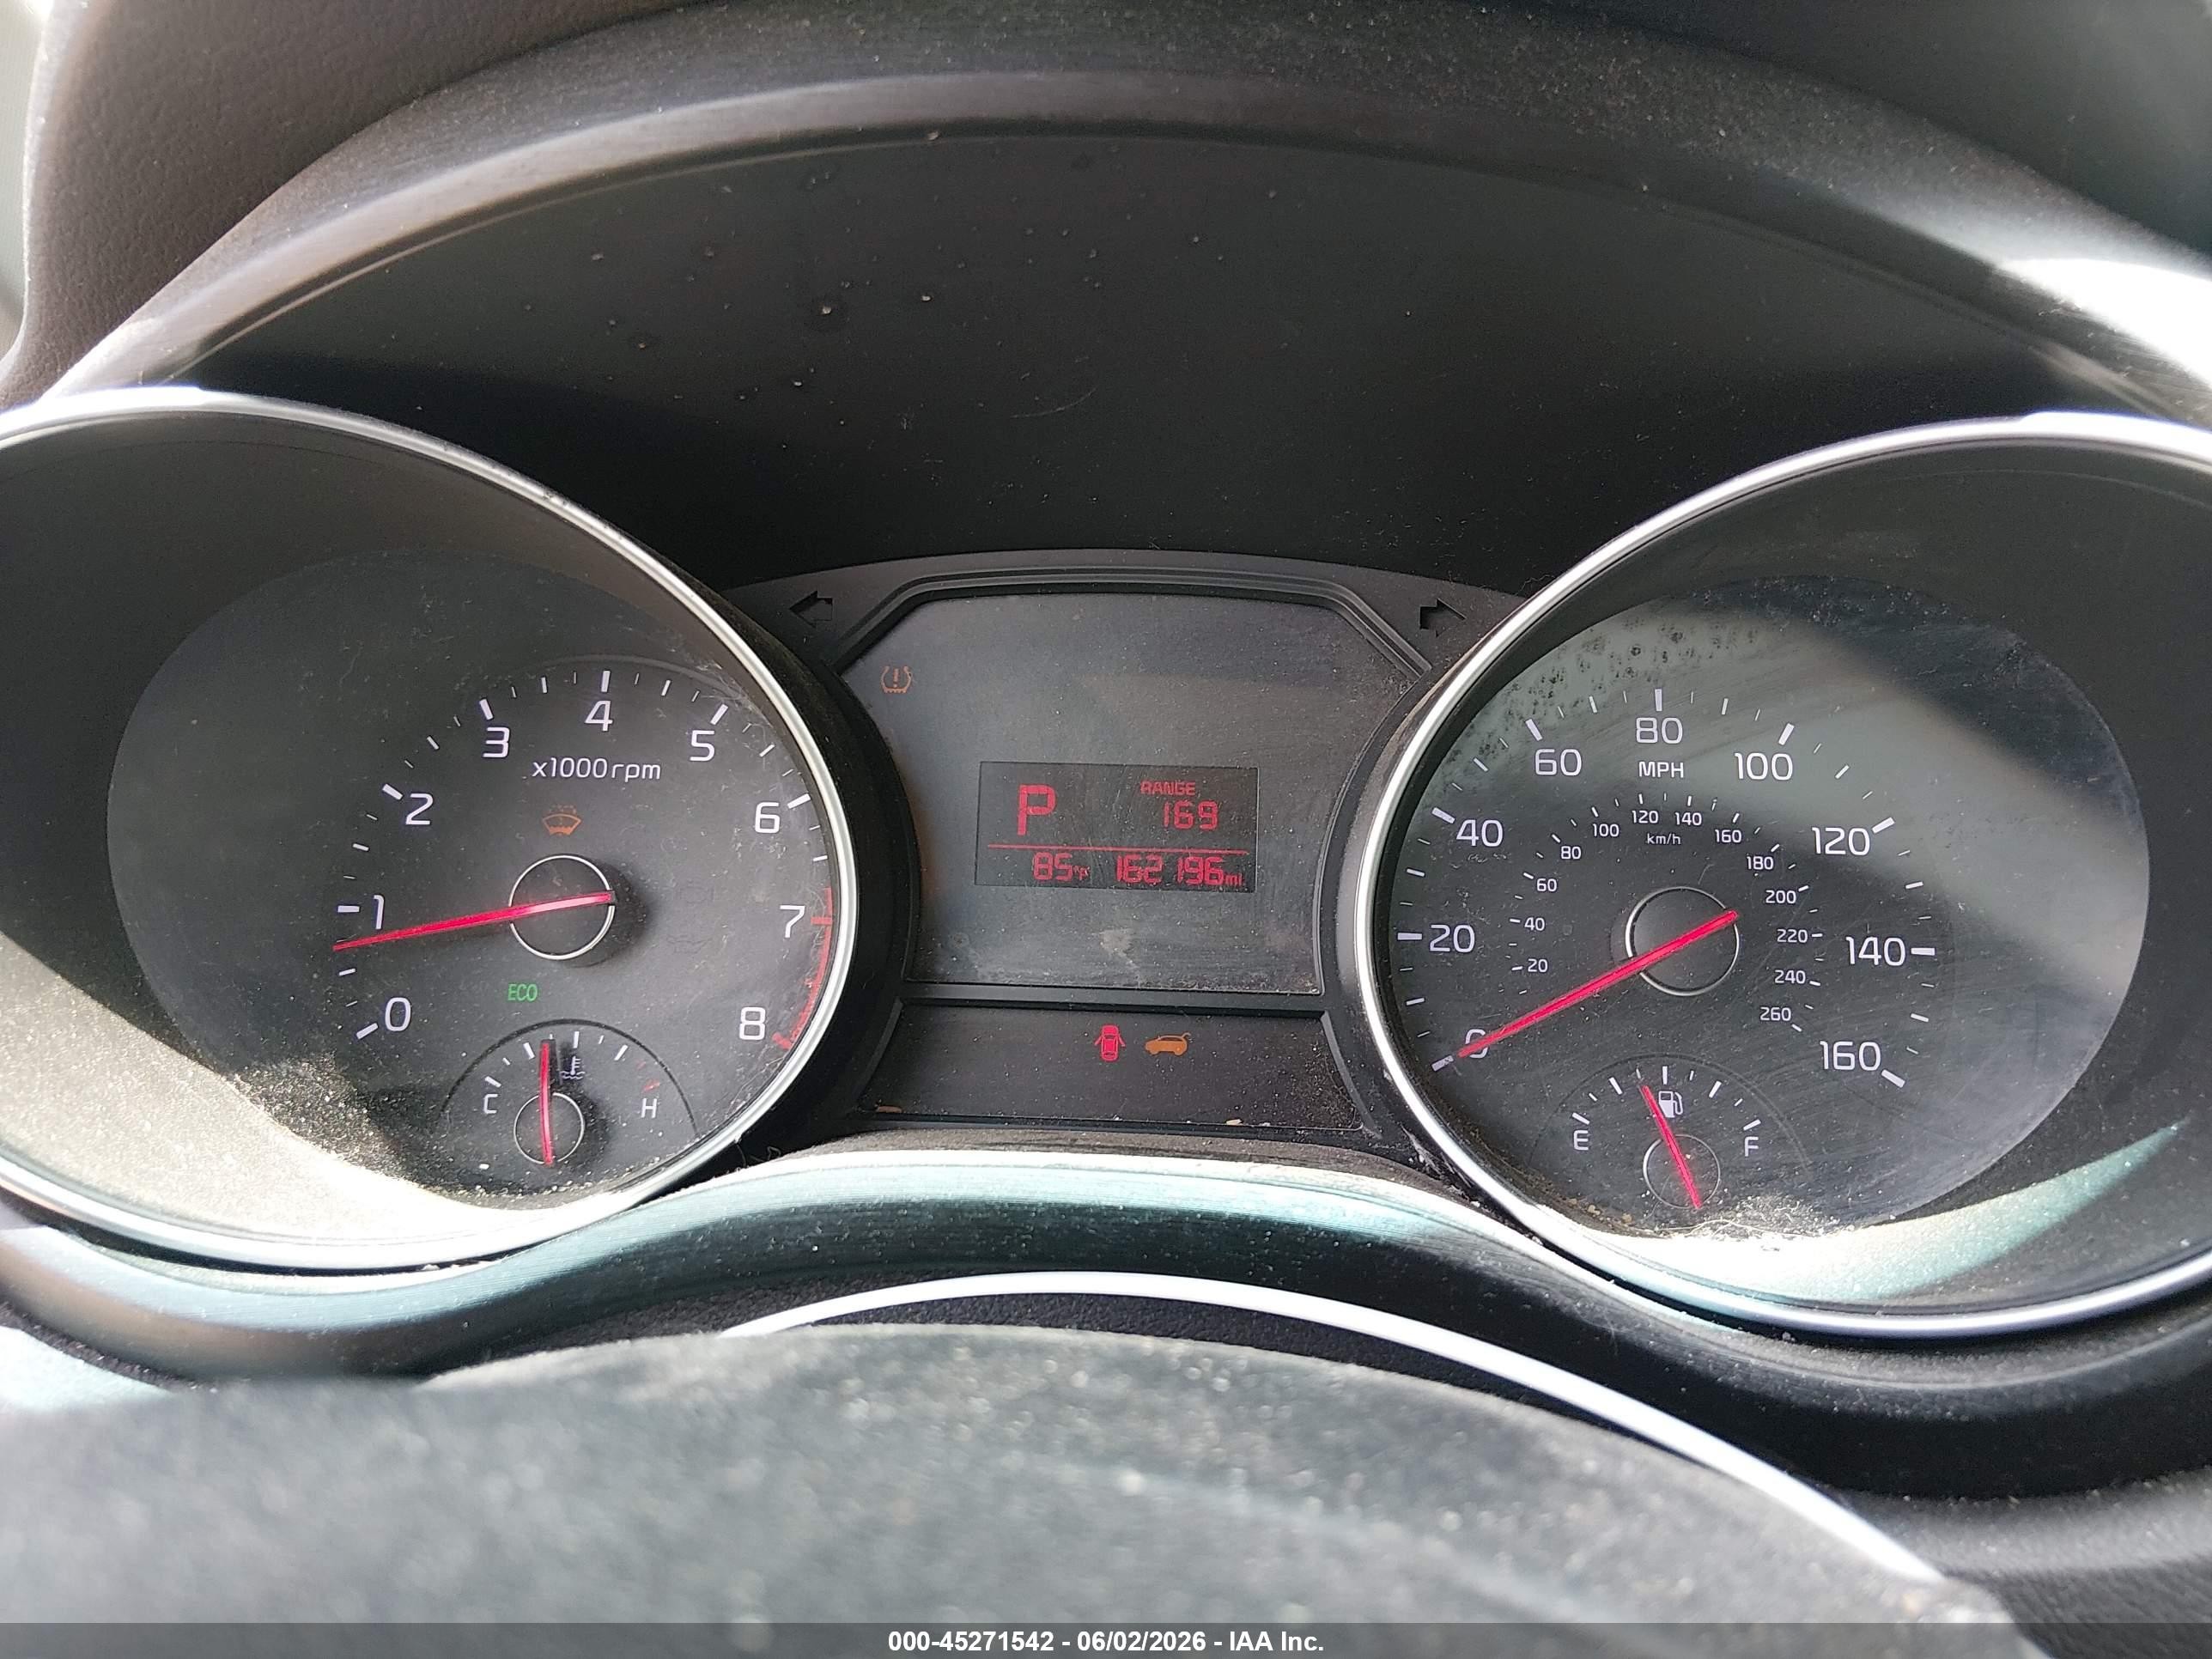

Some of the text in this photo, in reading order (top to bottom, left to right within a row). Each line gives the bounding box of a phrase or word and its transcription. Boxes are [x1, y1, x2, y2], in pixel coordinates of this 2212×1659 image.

[586, 701, 612, 731] 4
[1637, 718, 1682, 744] 80
[483, 727, 509, 757] 3
[690, 731, 714, 761] 5
[1535, 750, 1581, 775] 60
[1639, 762, 1683, 777] MPH
[1735, 753, 1792, 780] 100
[1140, 780, 1195, 795] RANGE
[406, 793, 433, 824] 2
[755, 803, 780, 833] 6
[1017, 784, 1056, 836] P
[1164, 800, 1218, 830] 169
[1632, 811, 1658, 823] 120
[1675, 812, 1701, 825] 140
[1456, 820, 1502, 846] 40
[1593, 823, 1619, 836] 100
[1648, 834, 1680, 844] km/h
[1716, 830, 1741, 842] 160
[1813, 828, 1869, 855] 120
[1561, 846, 1581, 859] 80
[1747, 856, 1773, 869] 180
[1537, 878, 1557, 891] 60
[1766, 890, 1796, 903] 200
[374, 895, 384, 929] 1
[781, 905, 805, 938] 7
[1525, 918, 1545, 931] 40
[1431, 925, 1474, 952] 20
[1778, 929, 1808, 943] 220
[1846, 937, 1905, 965] 140
[1528, 959, 1547, 972] 20
[1775, 970, 1805, 983] 240
[508, 985, 538, 1001] ECO
[386, 998, 410, 1031] 0
[739, 1007, 765, 1040] 8
[1760, 1007, 1791, 1021] 260
[1820, 1042, 1881, 1070] 160
[484, 1094, 497, 1114] C
[641, 1098, 657, 1118] H
[1574, 1130, 1589, 1150] E
[1745, 1137, 1759, 1156] F
